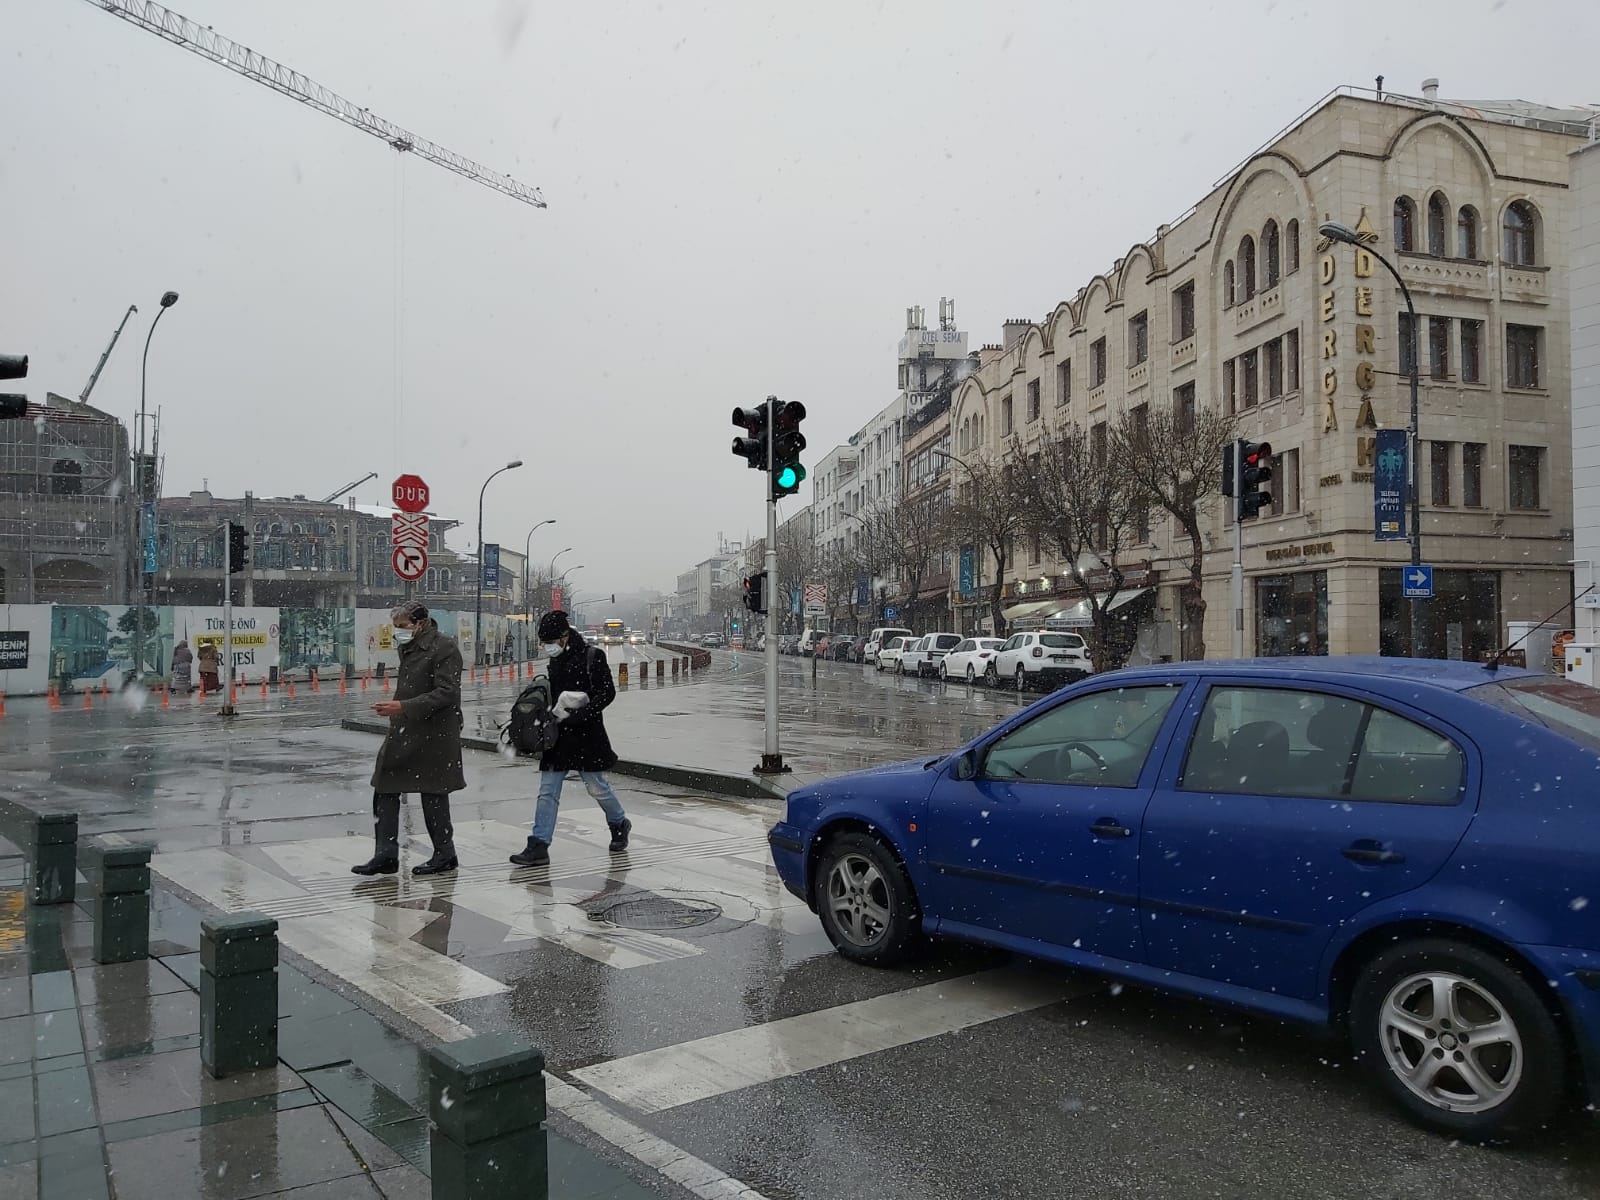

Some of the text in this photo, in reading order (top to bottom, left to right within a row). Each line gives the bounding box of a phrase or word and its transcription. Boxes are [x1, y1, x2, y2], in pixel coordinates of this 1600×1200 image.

[922, 331, 962, 343] OTEL SEMA
[395, 486, 426, 502] DUR
[887, 608, 894, 617] P
[206, 617, 256, 630] TÜRE ÖNÜ
